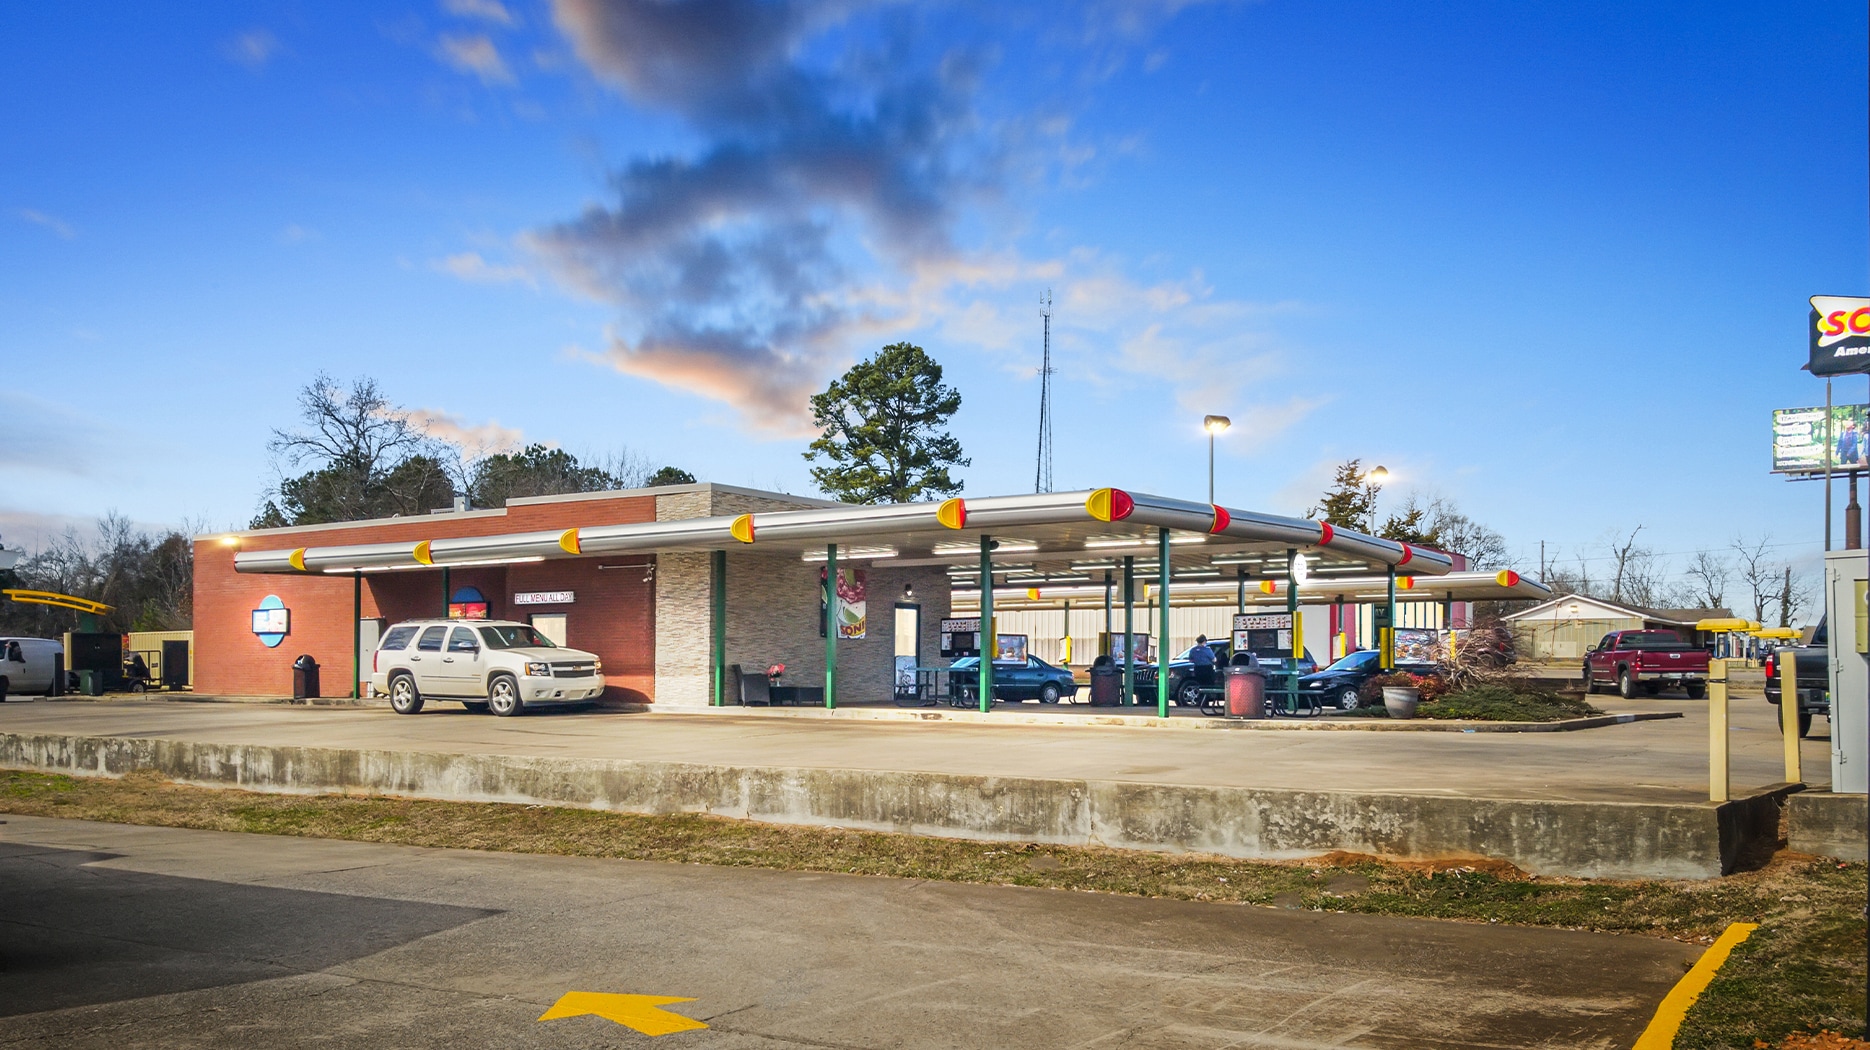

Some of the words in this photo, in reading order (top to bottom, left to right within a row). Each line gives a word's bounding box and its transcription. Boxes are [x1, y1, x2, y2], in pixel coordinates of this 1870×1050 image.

[516, 594, 529, 603] FULL
[531, 594, 548, 602] MENU
[549, 593, 559, 602] ALL
[560, 593, 573, 601] DAY
